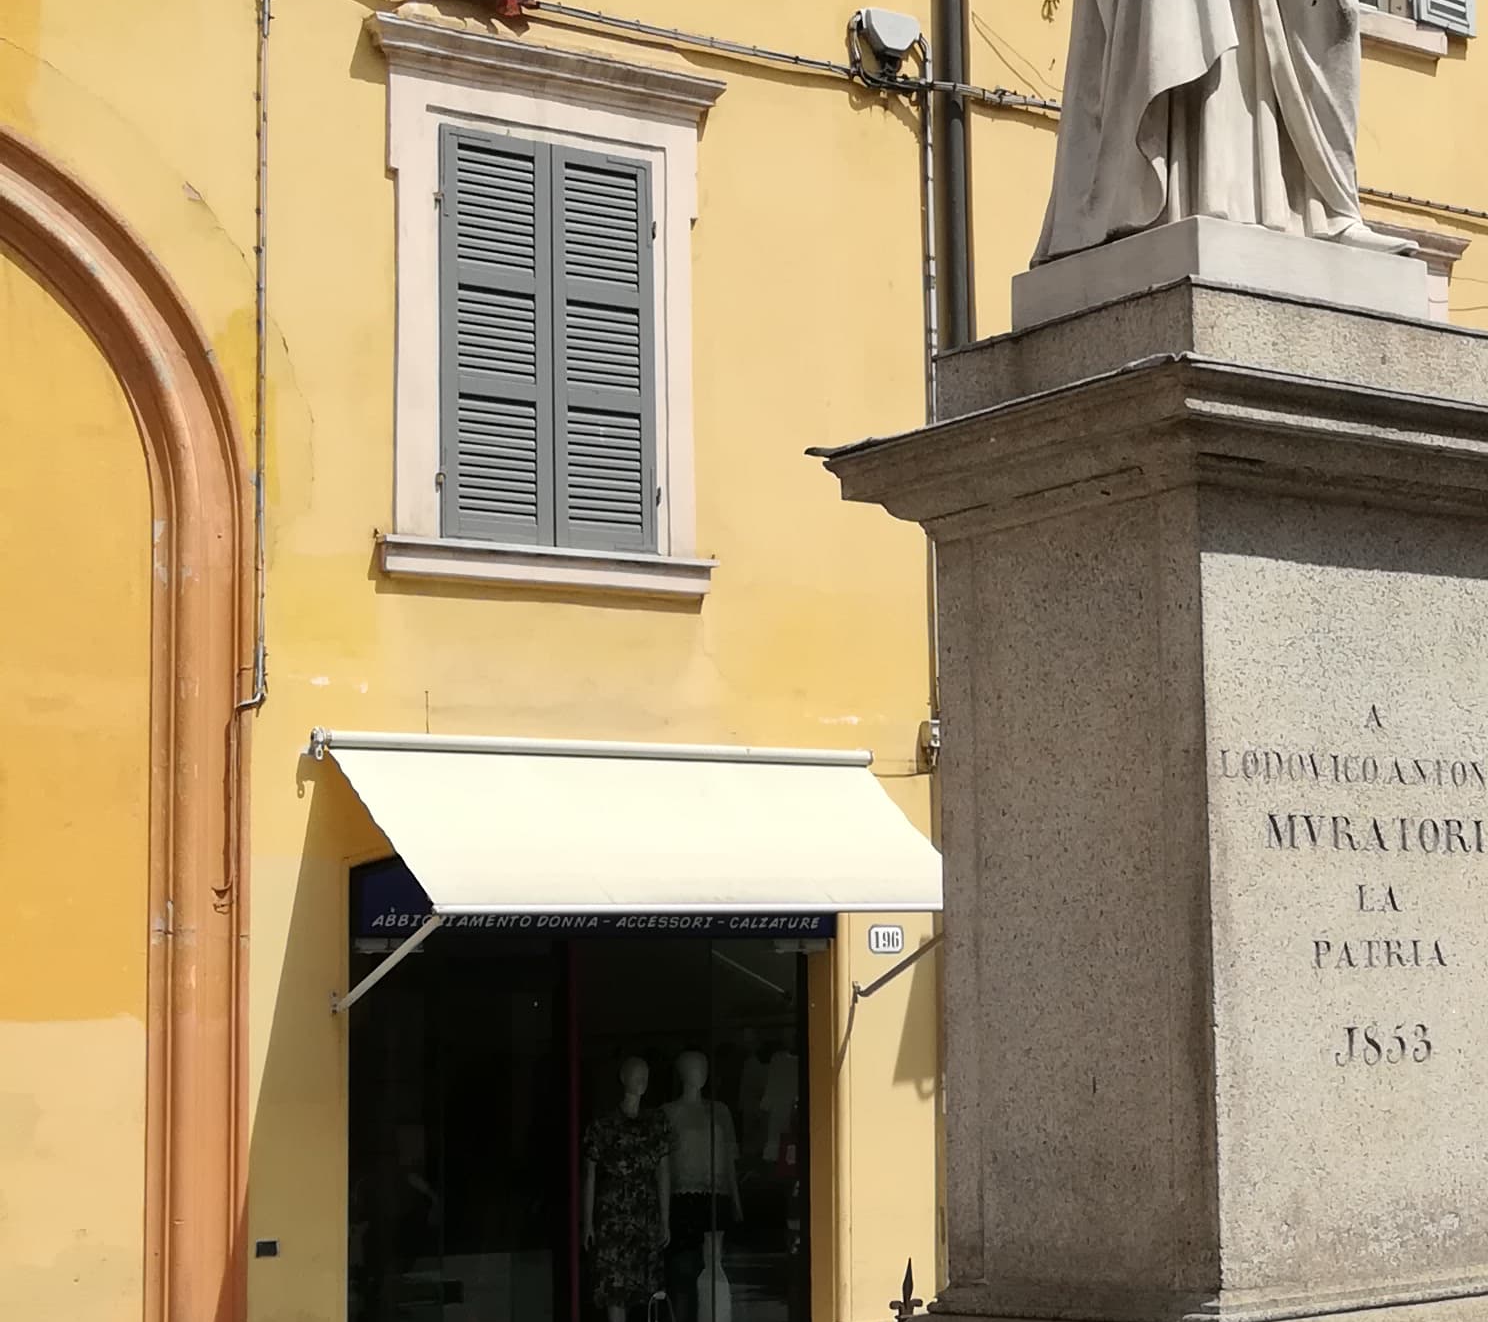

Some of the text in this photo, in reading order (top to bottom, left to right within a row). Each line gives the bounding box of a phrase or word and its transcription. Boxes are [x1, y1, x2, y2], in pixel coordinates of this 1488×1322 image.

[1364, 704, 1383, 728] A
[1219, 749, 1378, 785] LODOVICO
[1265, 813, 1486, 854] MVRATORI
[1356, 883, 1403, 913] LA
[536, 914, 599, 927] DONNA
[616, 915, 713, 929] ACCESSORI
[729, 916, 821, 930] CALZATURE
[873, 930, 899, 950] 196
[1311, 940, 1448, 969] PATRIA
[1335, 1024, 1433, 1067] 1853
